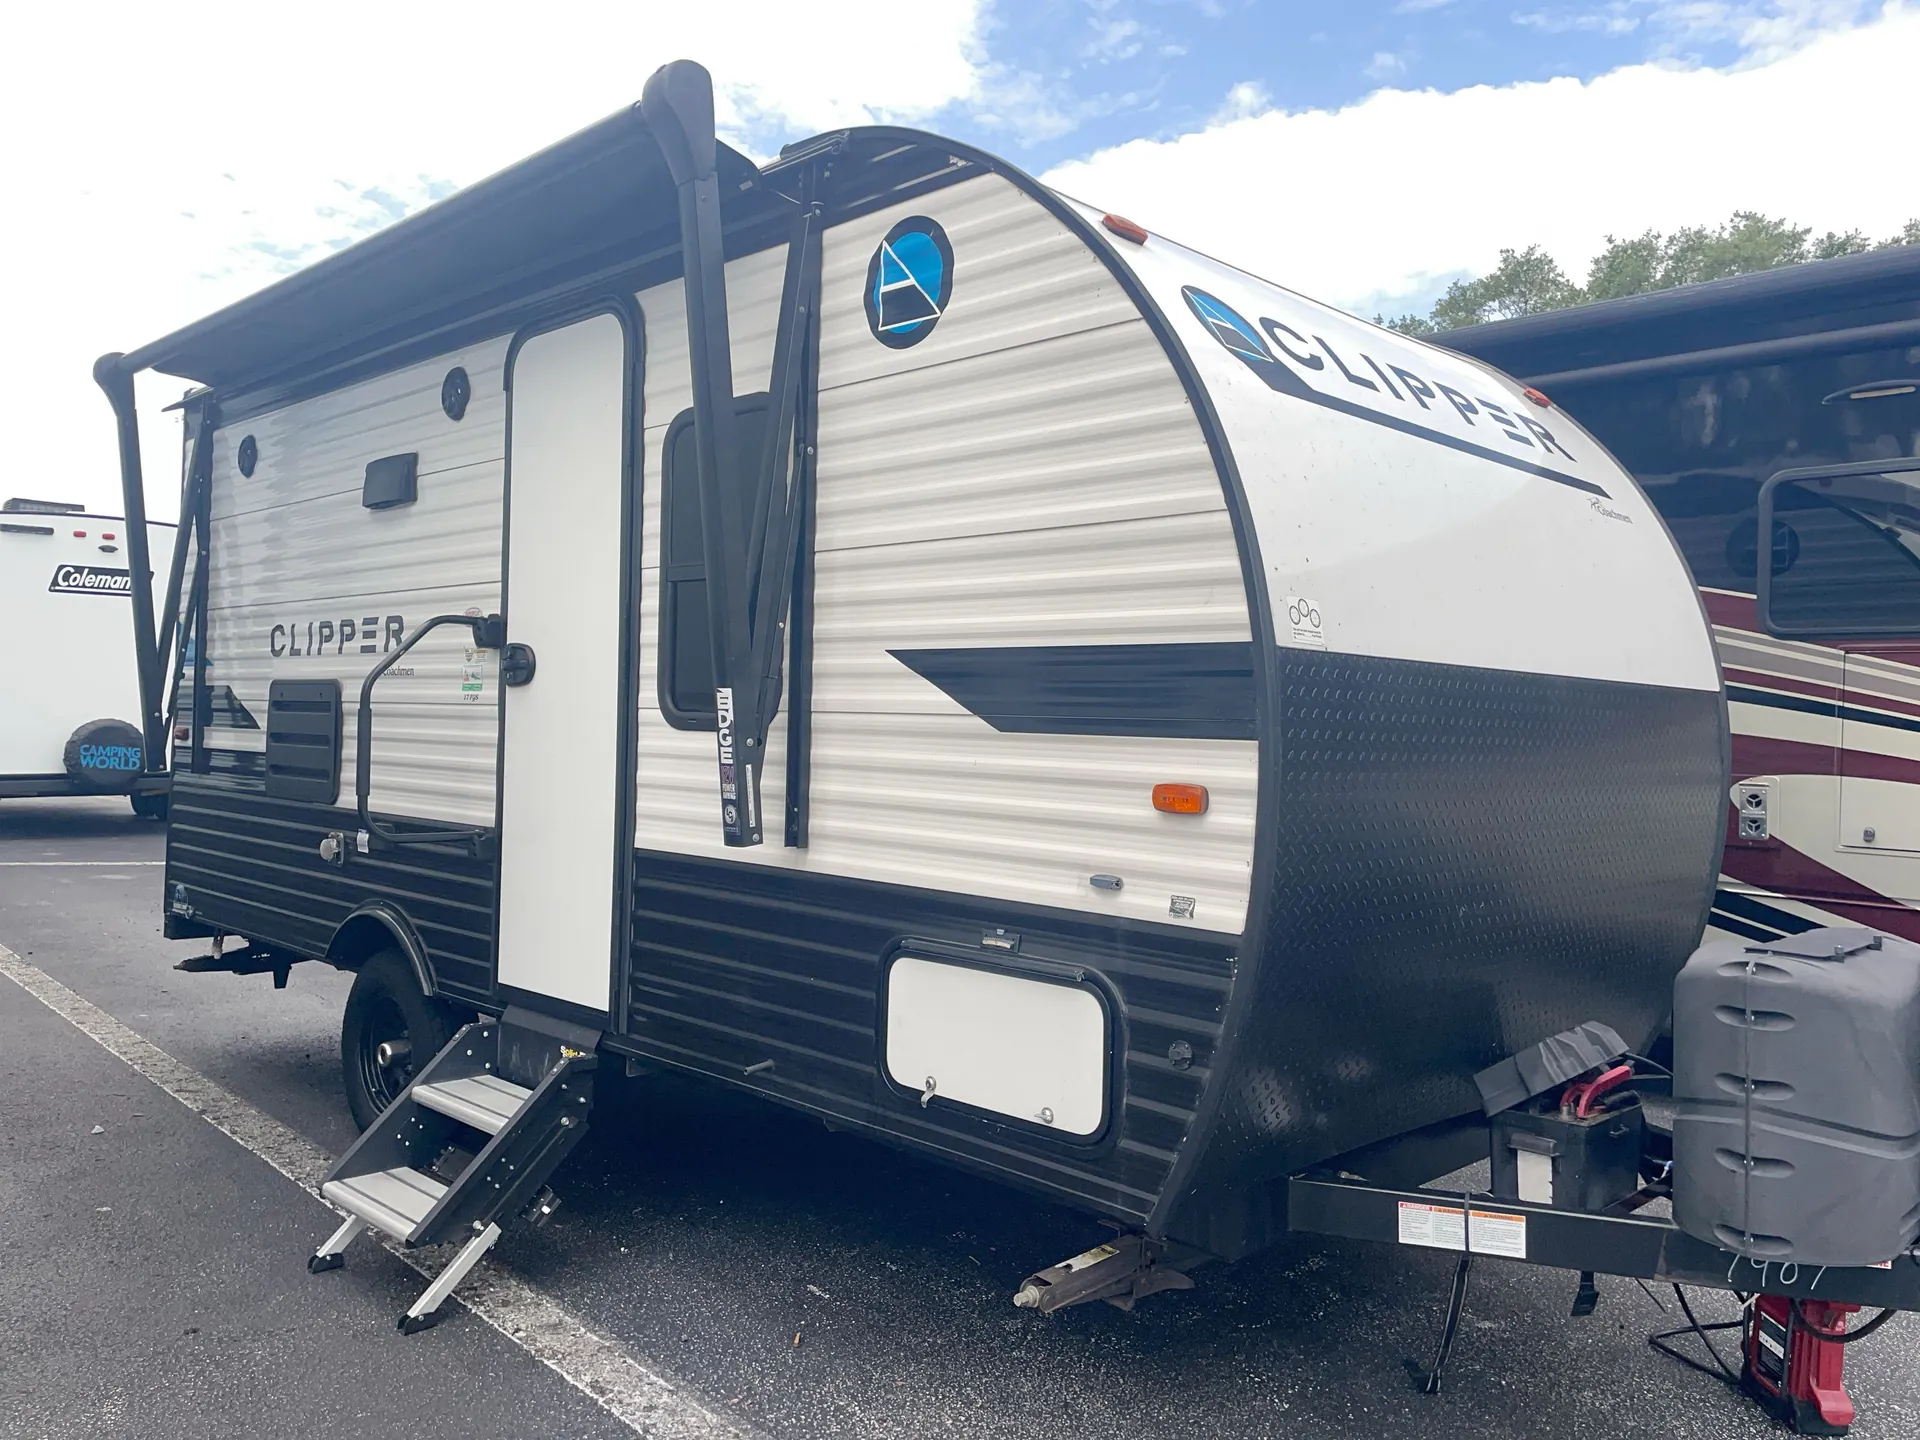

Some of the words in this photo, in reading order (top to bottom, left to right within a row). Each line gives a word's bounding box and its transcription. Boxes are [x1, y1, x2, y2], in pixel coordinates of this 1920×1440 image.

[1259, 317, 1578, 463] CLIPPER
[58, 567, 131, 589] Coleman
[270, 615, 404, 657] CLIPPER
[717, 691, 733, 764] EDGE
[80, 744, 140, 758] CAMPING
[80, 755, 140, 770] WORLD
